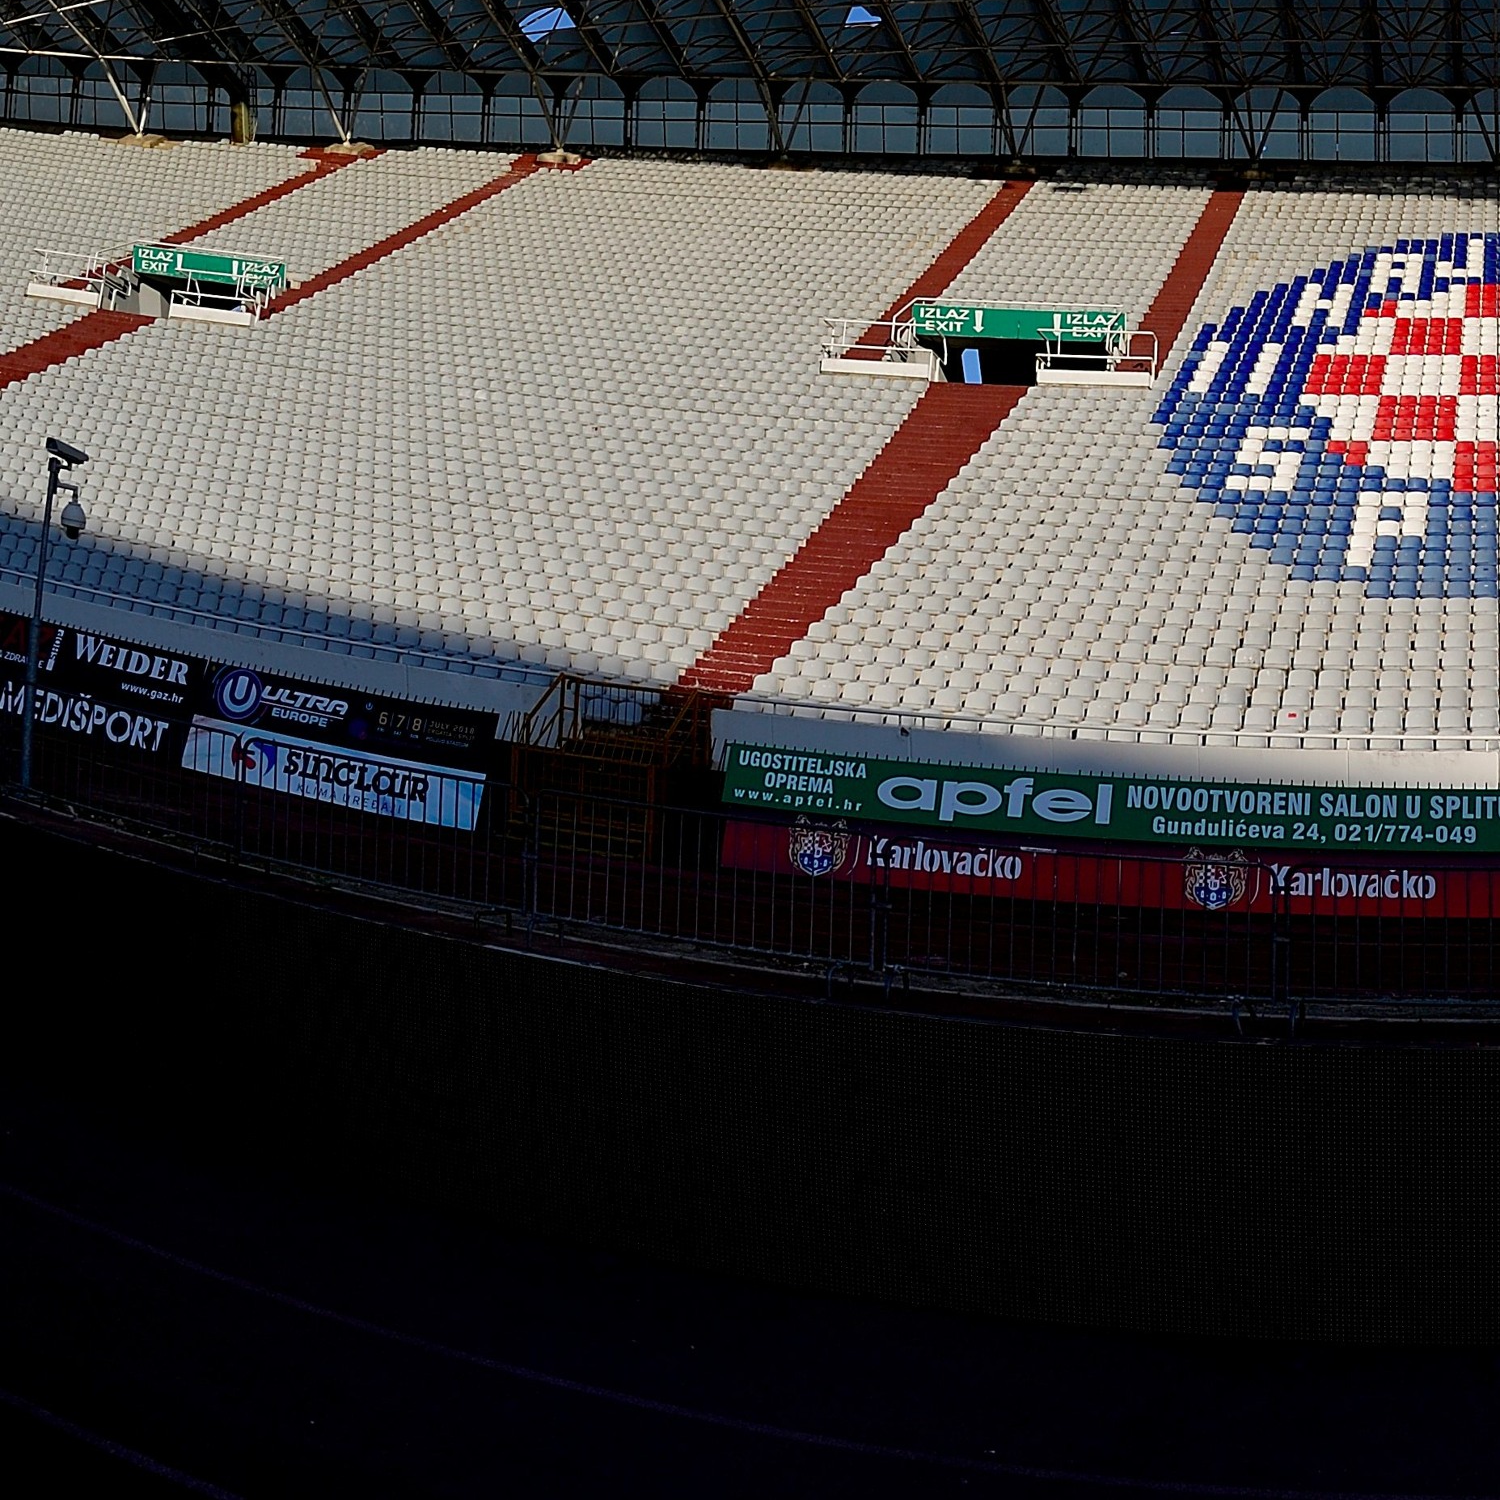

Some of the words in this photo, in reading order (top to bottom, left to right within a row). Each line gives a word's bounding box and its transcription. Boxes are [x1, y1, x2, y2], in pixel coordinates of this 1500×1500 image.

[138, 248, 174, 263] IZLAZ
[141, 260, 169, 273] EXIT
[242, 261, 280, 275] IZLAZ
[919, 307, 970, 321] IZLAZ
[1066, 313, 1118, 327] IZLAZ
[925, 321, 964, 333] EXIT
[4, 651, 44, 669] ZDRAE
[76, 633, 189, 686] WEIDER
[121, 682, 184, 704] www.gaz.hr
[261, 685, 349, 716] ULTRA
[271, 707, 328, 728] EUROPE
[429, 720, 451, 730] JULY
[739, 750, 867, 779] UGOSTITELJSKA
[764, 771, 834, 794] OPREMA
[877, 776, 1113, 825] apfel
[1126, 785, 1311, 816] NOVOOTVORENI
[1319, 793, 1397, 818] SALON
[1405, 795, 1421, 819] U
[1152, 816, 1285, 840] Gundulićeva
[1292, 822, 1326, 844] 24,
[1334, 824, 1477, 845] 021/774-049
[867, 835, 1022, 880] Karlovačko
[1269, 862, 1437, 900] Karlovačko
